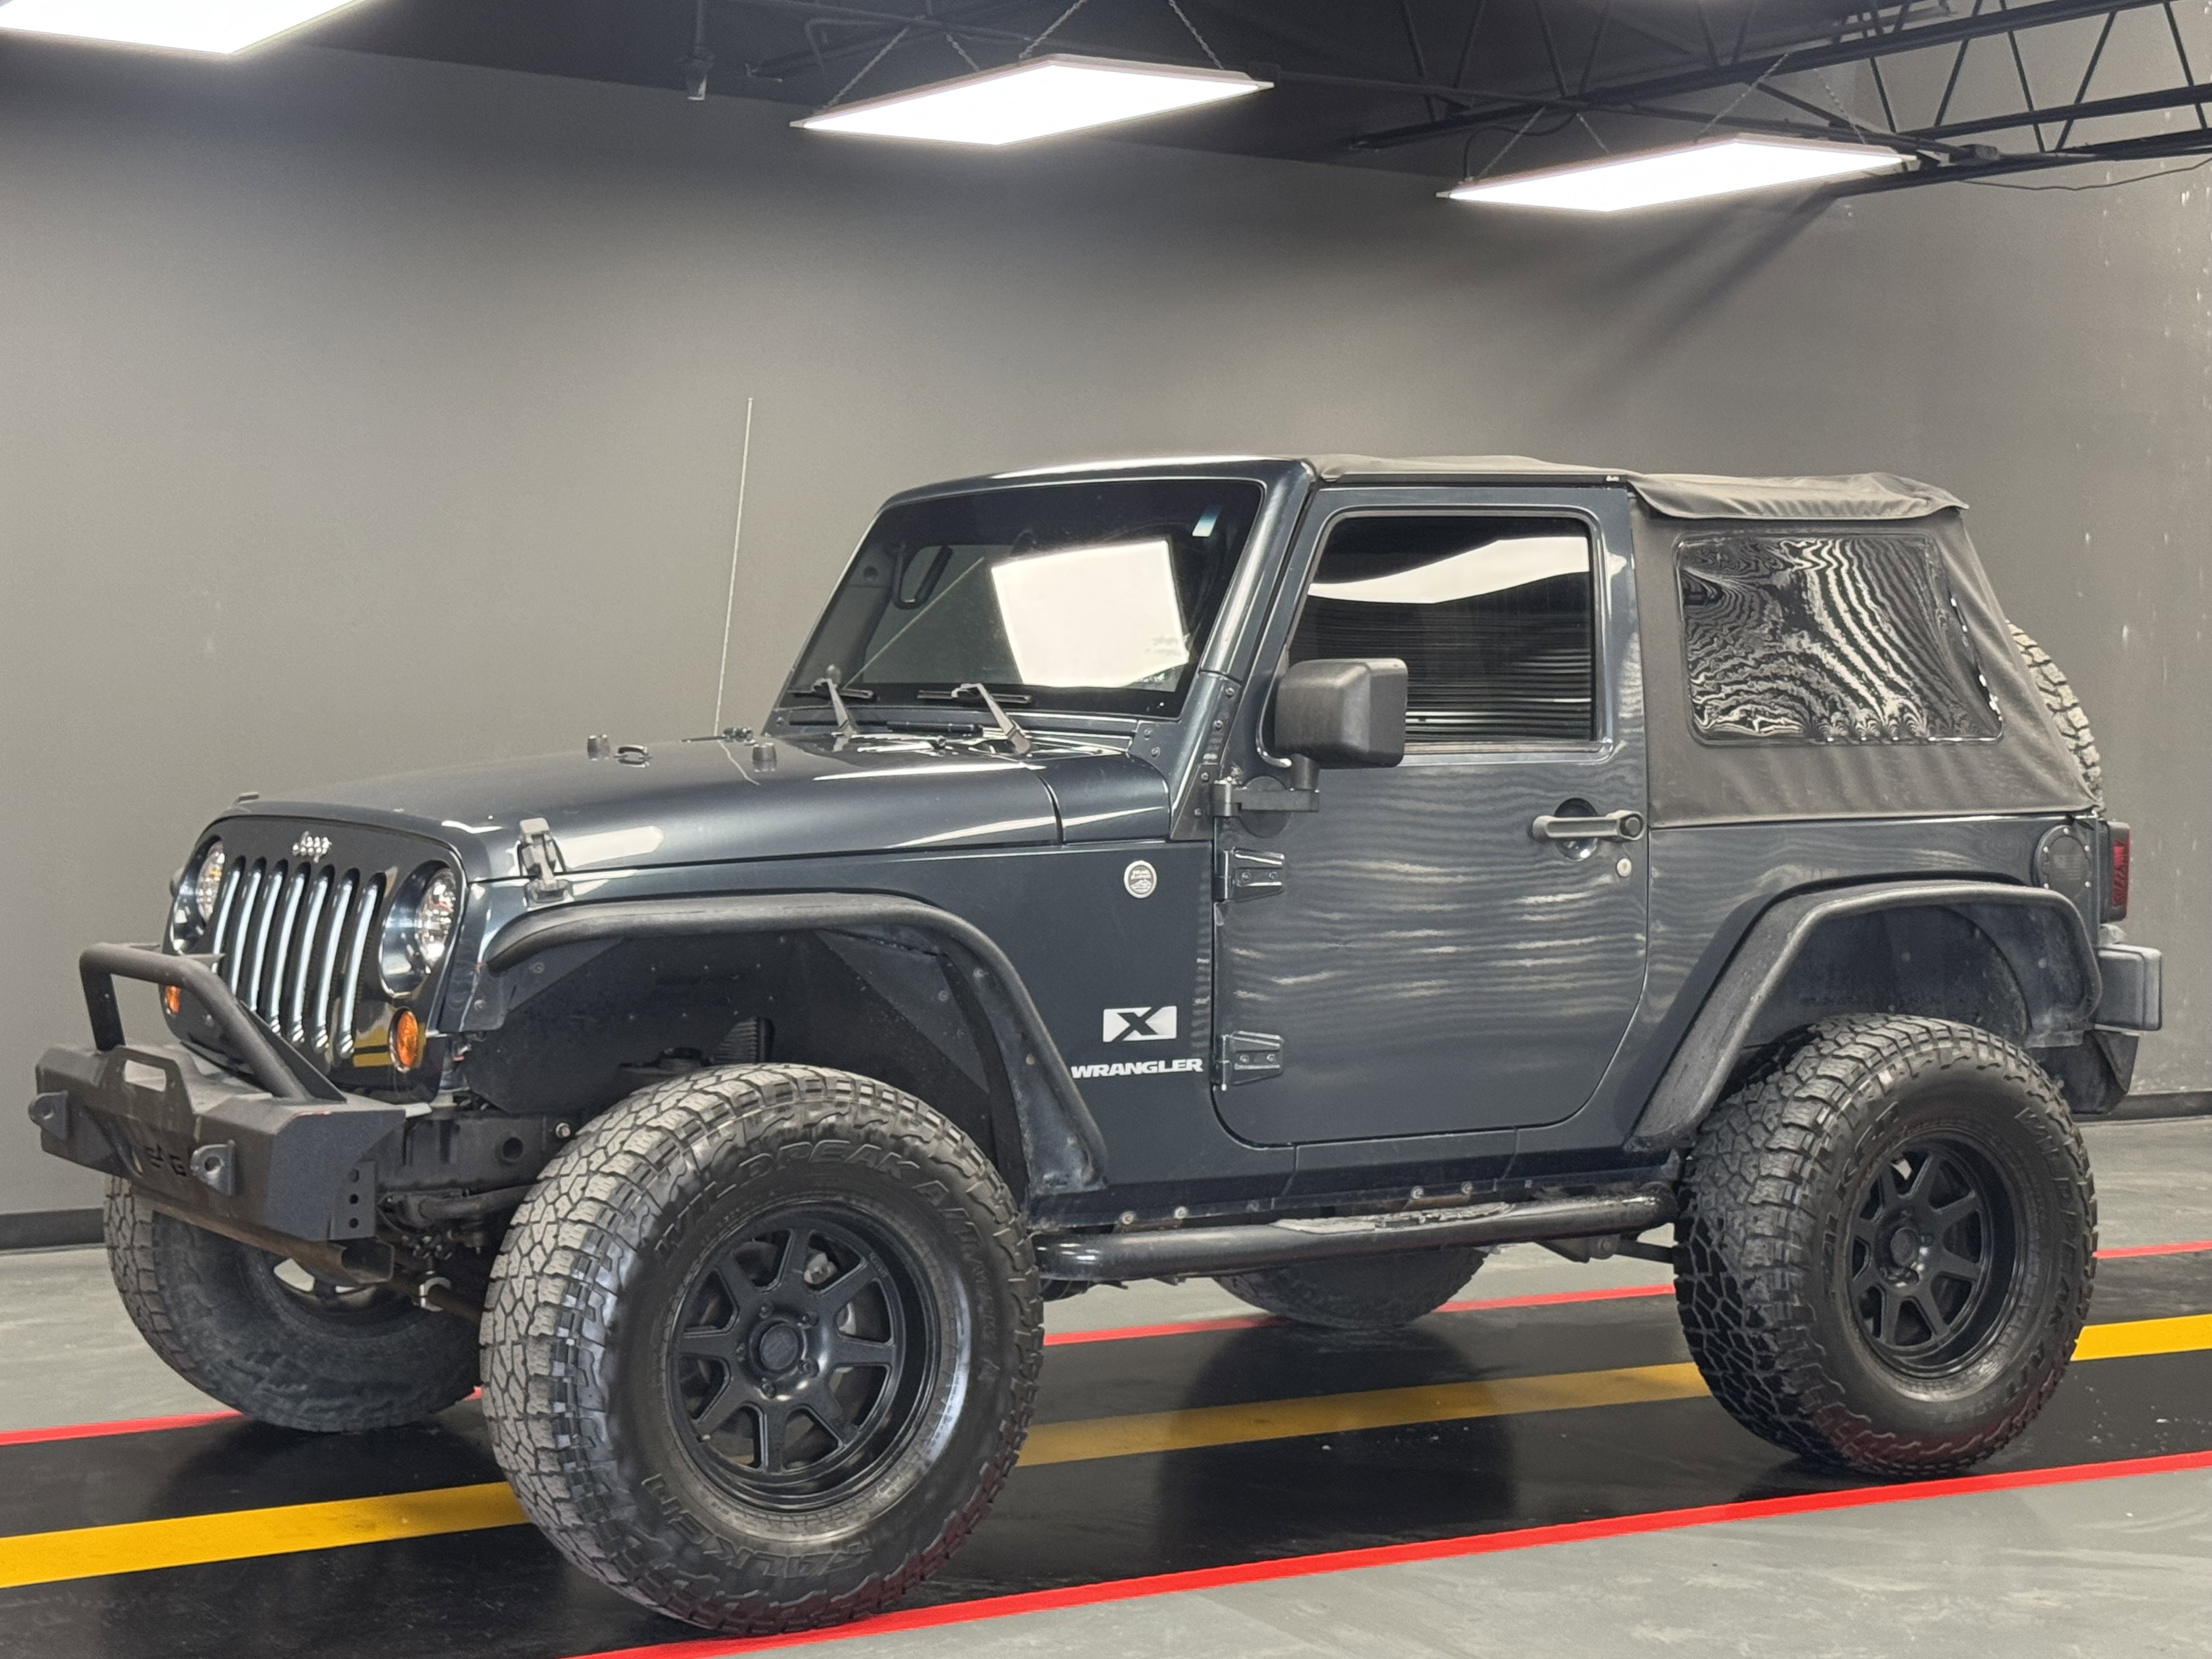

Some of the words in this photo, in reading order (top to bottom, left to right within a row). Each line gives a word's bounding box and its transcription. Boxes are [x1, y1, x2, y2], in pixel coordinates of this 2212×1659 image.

[1111, 1006, 1169, 1042] X
[1071, 1058, 1204, 1079] WRANGLER
[653, 1139, 920, 1263] WILDPEAK
[641, 1473, 872, 1579] FALKEN
